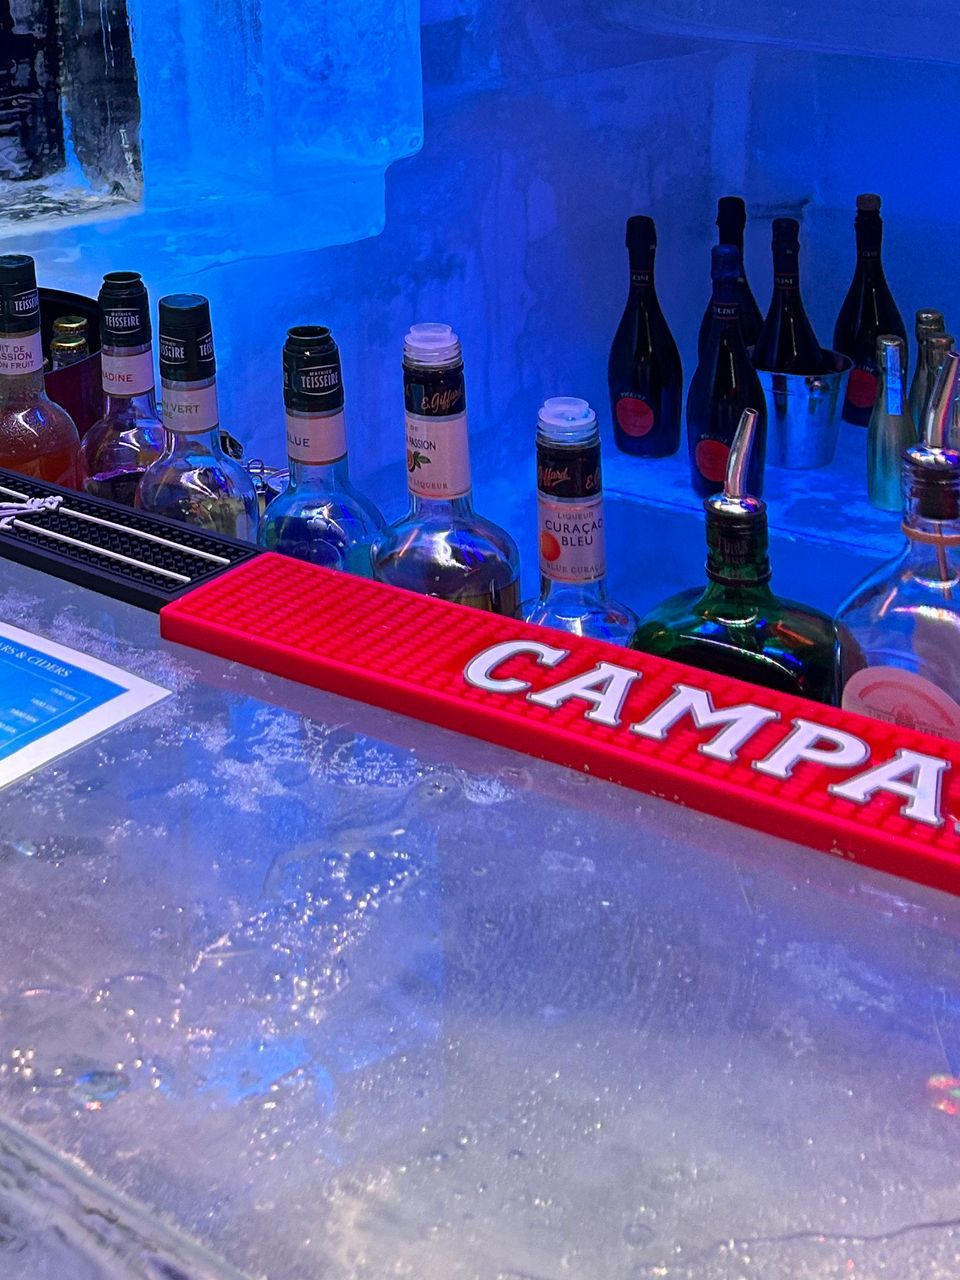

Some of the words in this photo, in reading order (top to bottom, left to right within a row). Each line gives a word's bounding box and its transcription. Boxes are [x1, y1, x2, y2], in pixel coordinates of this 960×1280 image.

[105, 315, 140, 327] TEISSEIRE
[13, 345, 25, 353] DE
[10, 360, 34, 369] FRUIT
[301, 372, 339, 388] TEISSEIRE
[173, 404, 200, 414] VERT
[557, 512, 594, 520] LIQUEUR
[561, 535, 593, 547] BLEU
[14, 650, 26, 661] &
[27, 655, 72, 678] CIDERS
[463, 639, 960, 834] CAMPA
